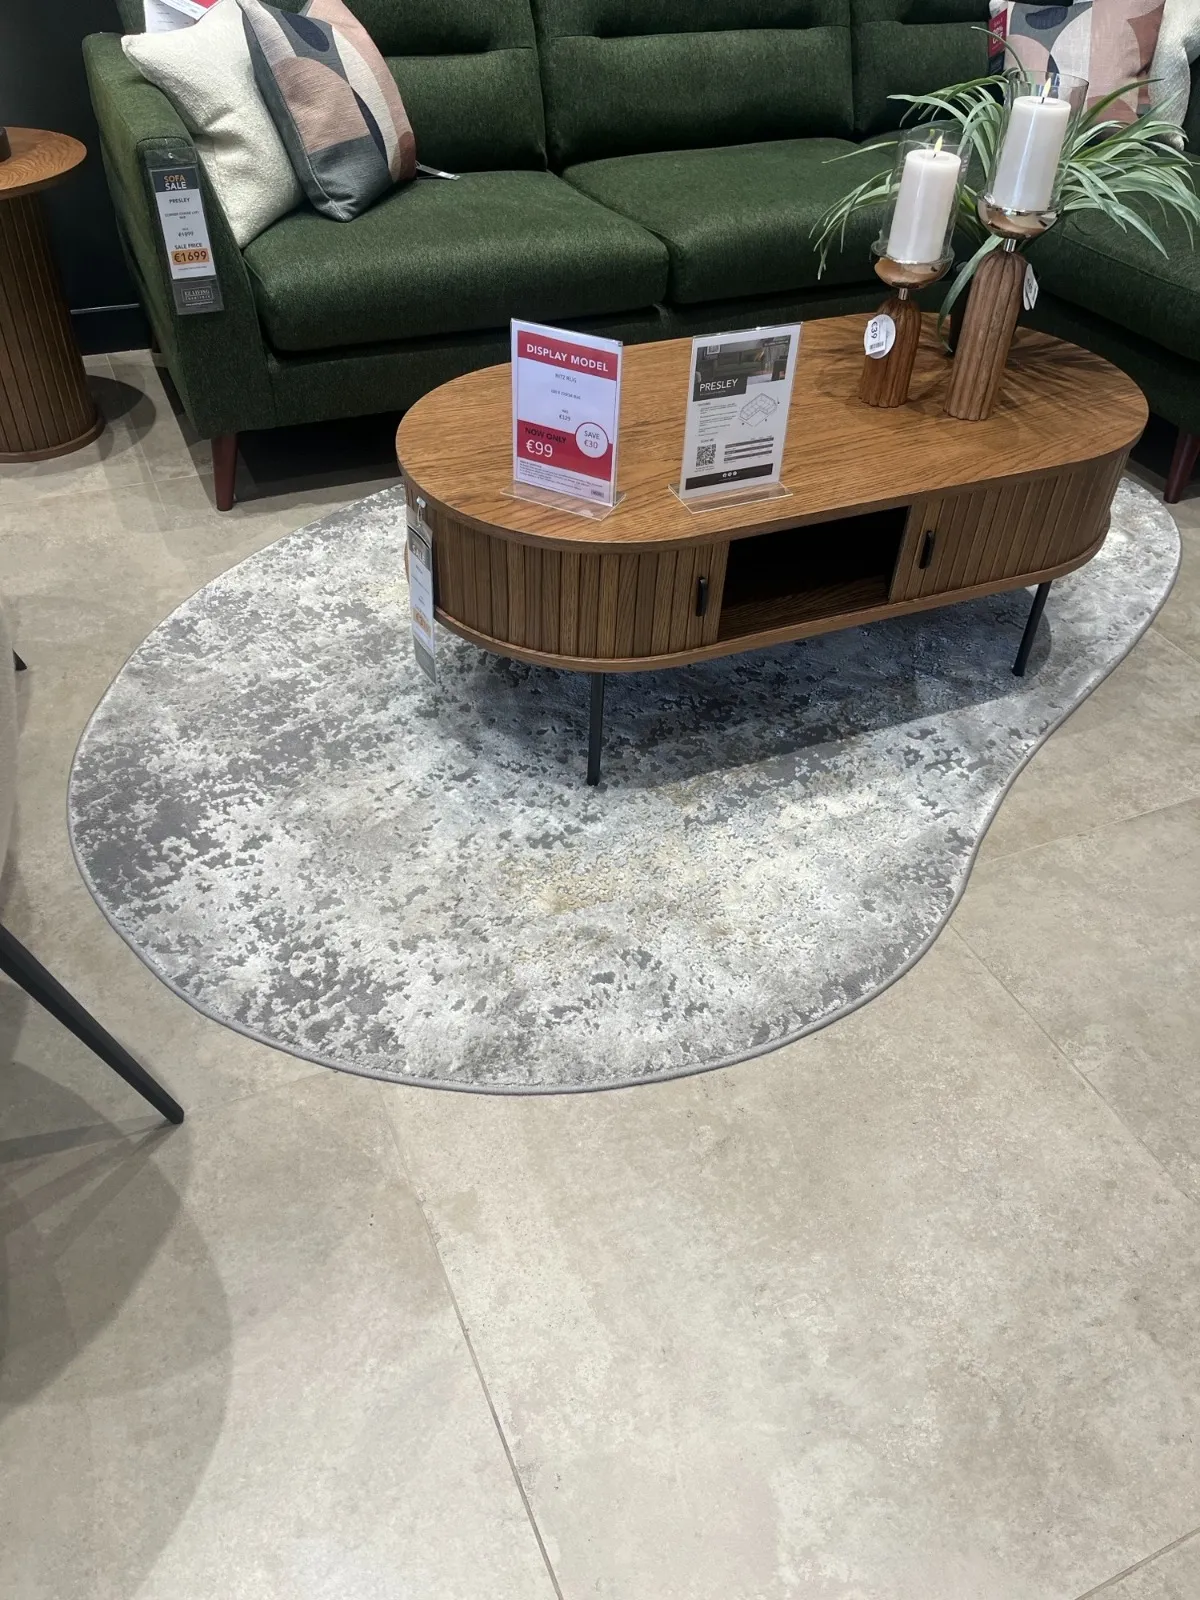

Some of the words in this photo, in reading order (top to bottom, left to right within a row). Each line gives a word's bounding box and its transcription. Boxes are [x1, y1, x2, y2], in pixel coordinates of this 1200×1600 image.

[164, 175, 186, 183] SOFA
[165, 182, 187, 191] SALE
[174, 250, 207, 263] €1699
[870, 321, 878, 339] €39
[526, 343, 568, 362] DISPLAY
[570, 354, 609, 372] MODEL
[699, 378, 739, 392] PRESLEY
[525, 427, 546, 439] NOW
[546, 433, 567, 444] ONLY
[584, 430, 600, 440] SAVE
[526, 439, 553, 458] €99
[583, 440, 598, 450] €30
